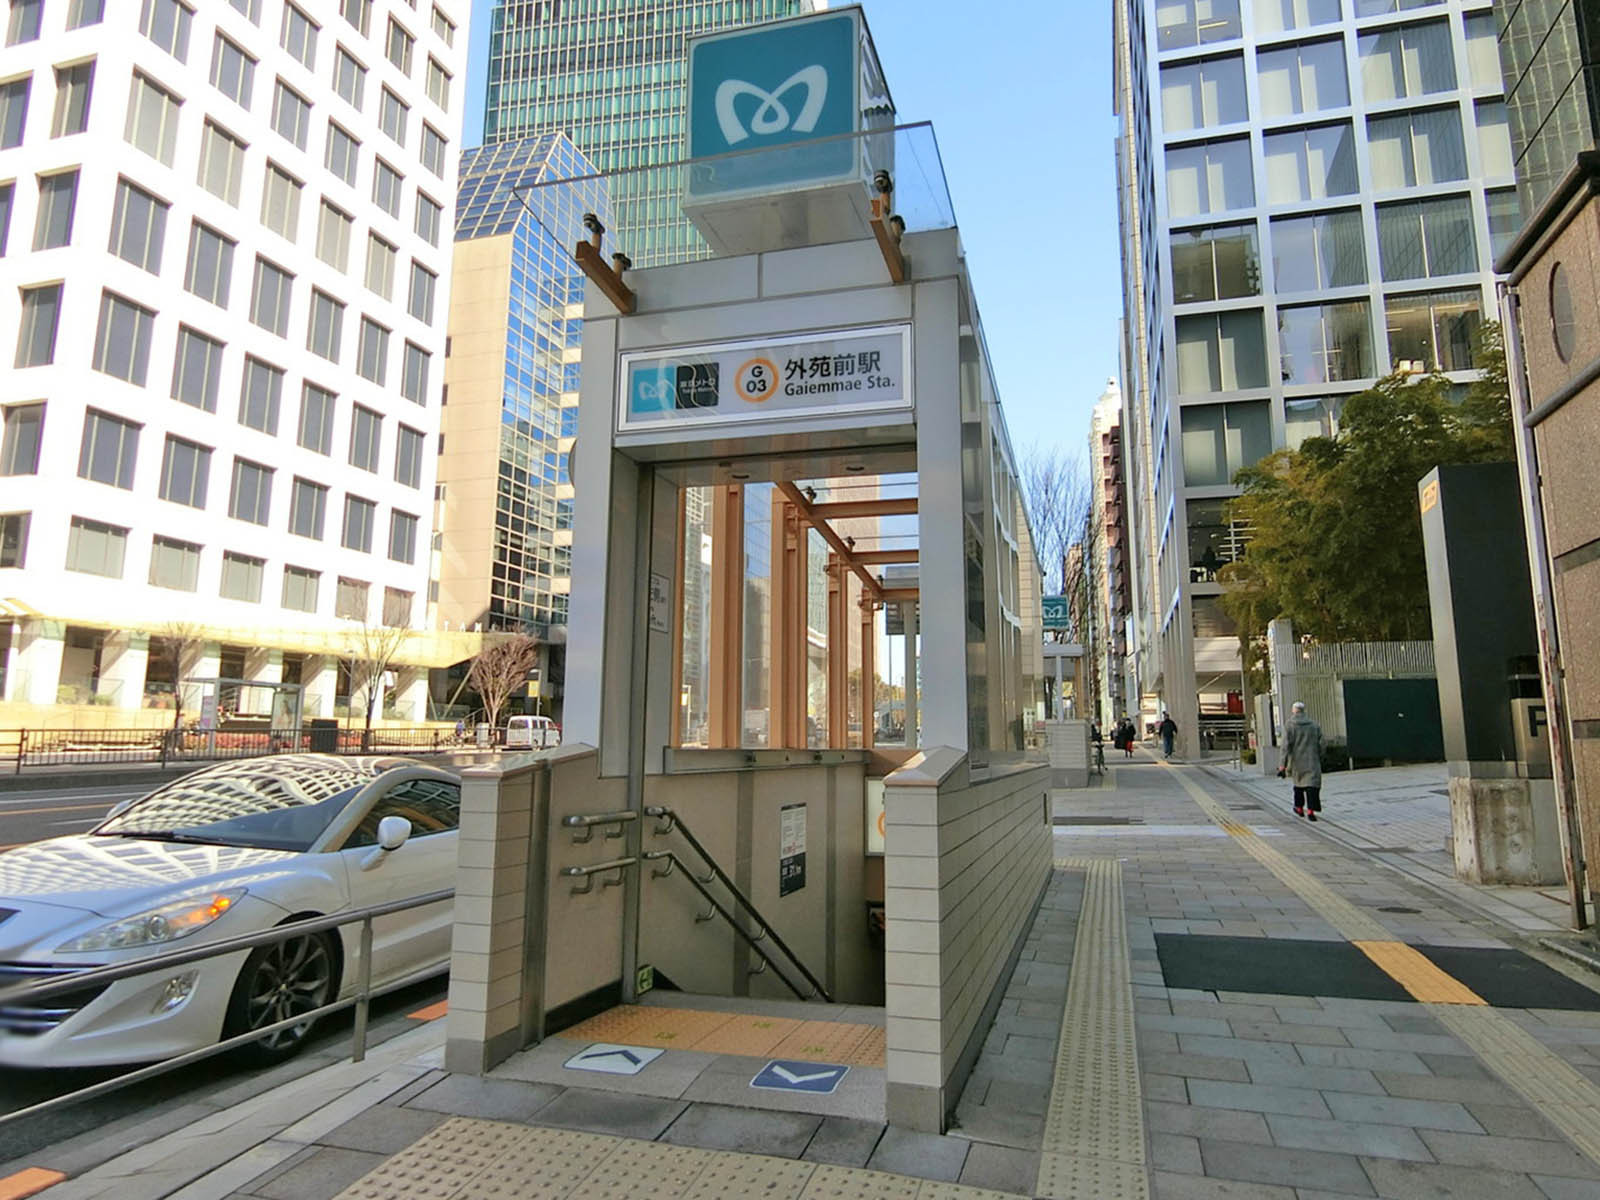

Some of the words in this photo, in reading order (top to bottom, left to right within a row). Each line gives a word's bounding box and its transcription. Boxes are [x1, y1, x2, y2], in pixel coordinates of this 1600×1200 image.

[752, 365, 763, 378] G
[785, 351, 881, 380] 外苑前駅
[746, 379, 766, 393] 03
[785, 379, 862, 396] Gaiemmae
[867, 375, 895, 389] Sta.
